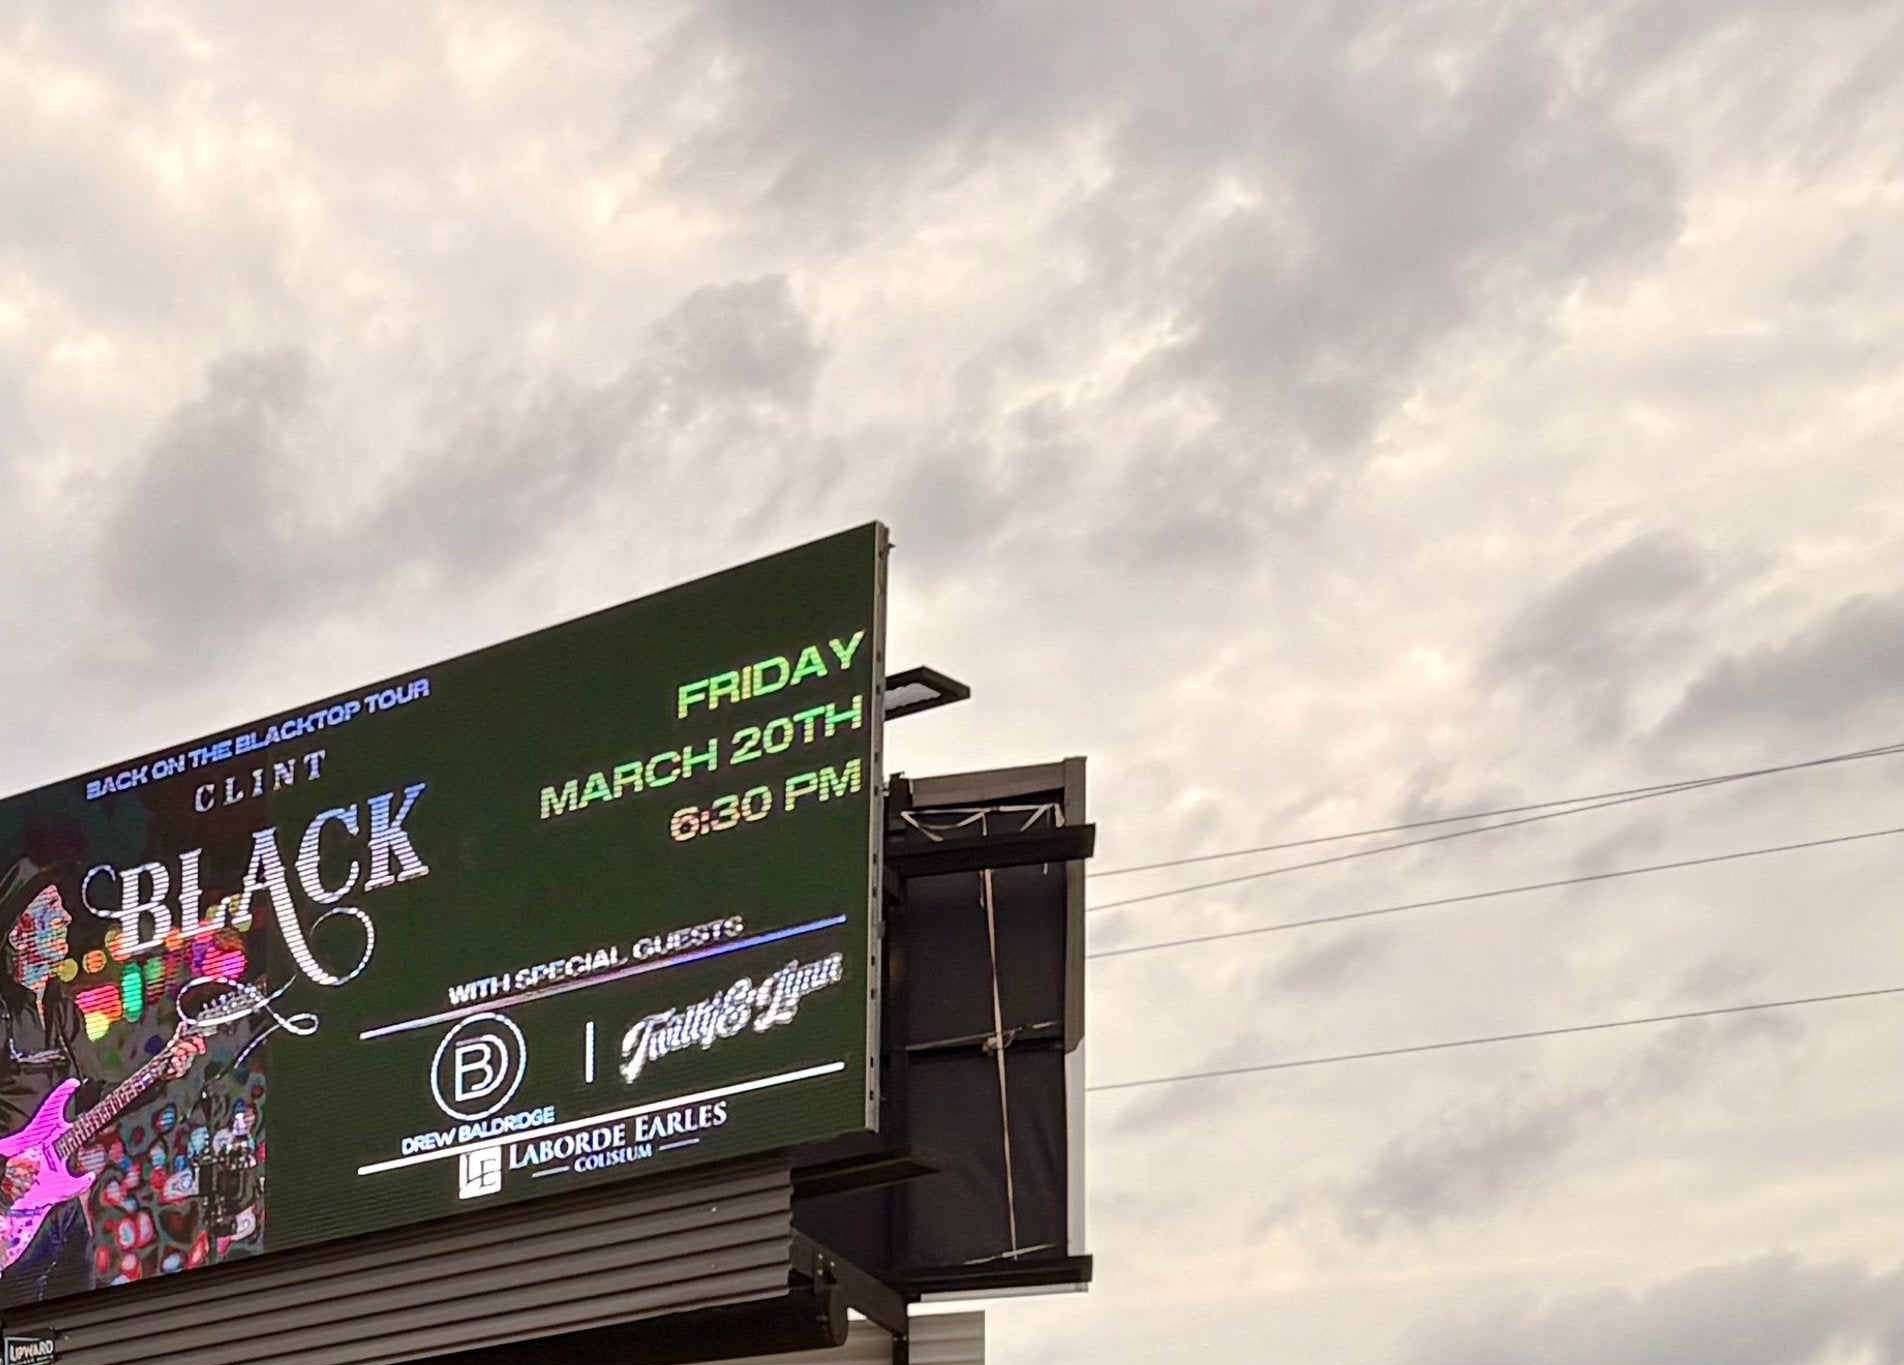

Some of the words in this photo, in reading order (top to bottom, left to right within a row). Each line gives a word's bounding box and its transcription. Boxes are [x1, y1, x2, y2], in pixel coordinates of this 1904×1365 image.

[677, 629, 865, 719] FRIDAY
[86, 765, 149, 800] BACK
[152, 754, 185, 780] ON
[188, 740, 233, 768] THE
[235, 701, 361, 755] BLACKTOP
[364, 678, 431, 714] TOUR
[194, 750, 326, 812] CLINT
[540, 738, 718, 819] MARCH
[730, 694, 863, 765] 20TH
[670, 785, 773, 842] 6:30
[784, 758, 862, 811] PM
[82, 782, 430, 986] BLACK
[448, 973, 510, 1005] WITH
[514, 946, 628, 990] SPECIAL
[632, 915, 744, 959] GUESTS
[401, 1130, 456, 1155] DREW
[458, 1105, 555, 1143] BALDRIDGE
[508, 1123, 625, 1170] LABORDE
[635, 1100, 727, 1142] EARLES
[574, 1144, 652, 1173] COLISEUM
[9, 1340, 54, 1362] UPWARD
